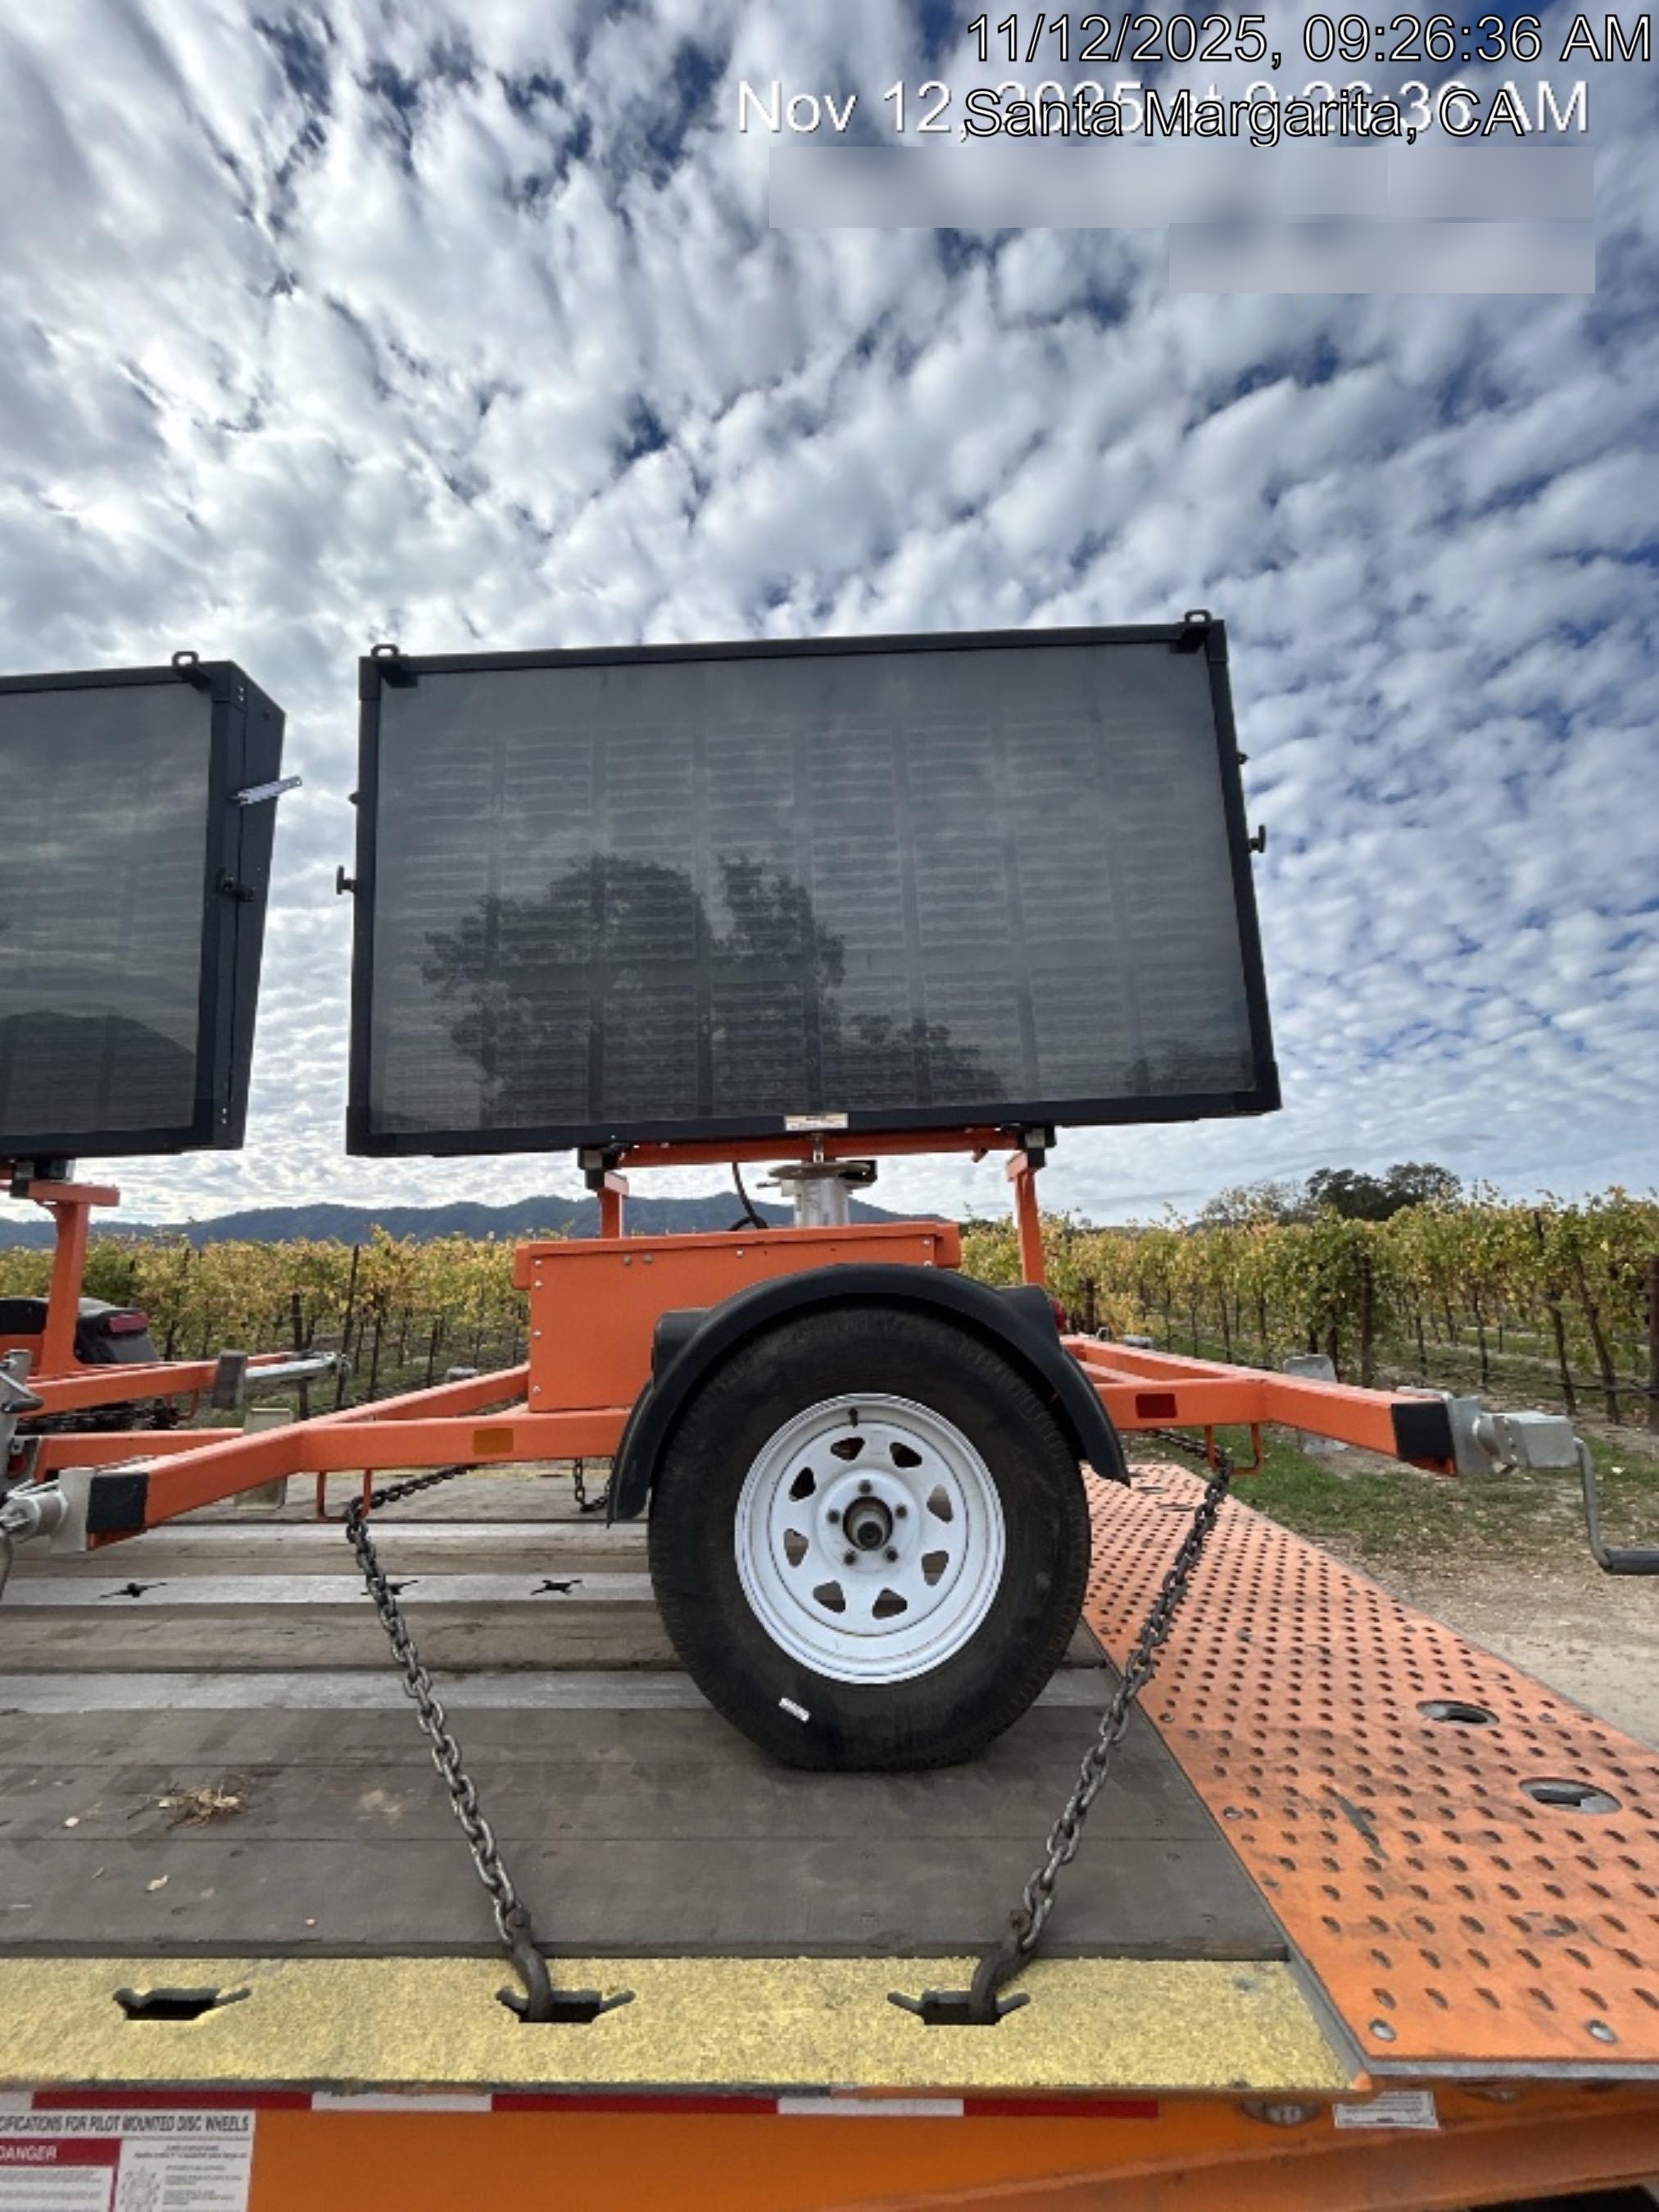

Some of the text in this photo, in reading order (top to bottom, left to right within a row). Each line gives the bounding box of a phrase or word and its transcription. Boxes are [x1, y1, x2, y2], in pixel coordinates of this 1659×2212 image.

[65, 2115, 87, 2132] FOR
[89, 2115, 120, 2132] PILOT
[123, 2115, 175, 2132] MOUNTED
[176, 2115, 202, 2132] DISC
[206, 2115, 249, 2132] WHEELS
